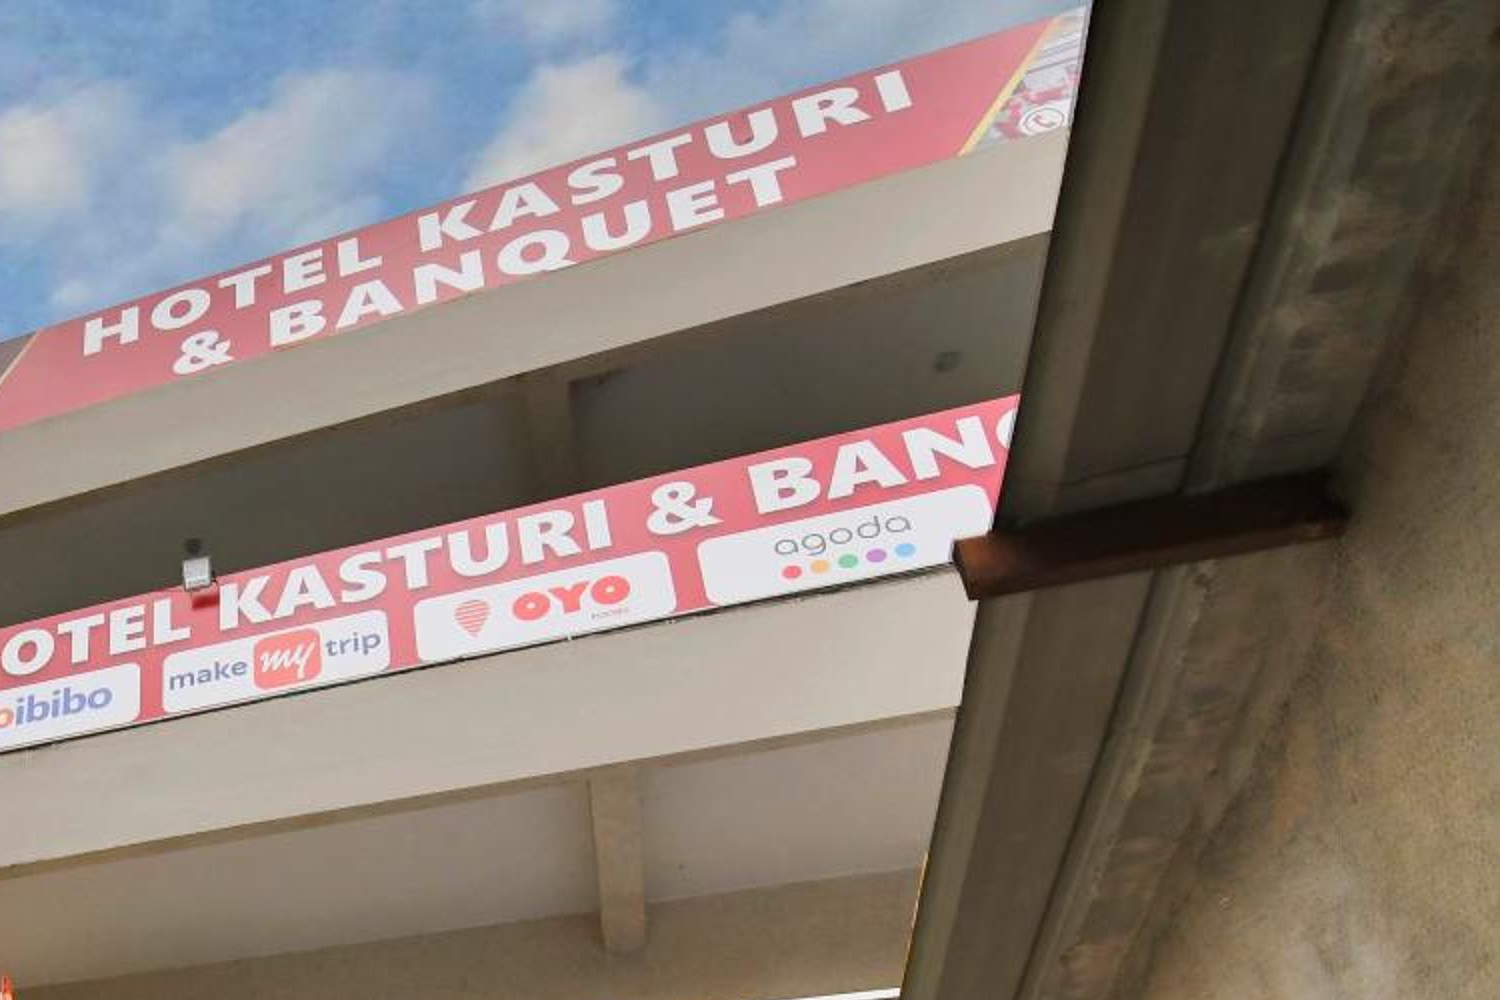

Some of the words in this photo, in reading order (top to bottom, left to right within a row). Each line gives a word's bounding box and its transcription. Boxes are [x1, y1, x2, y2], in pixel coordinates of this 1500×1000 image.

[84, 239, 382, 356] HOTEL
[418, 70, 912, 251] KASTURI
[173, 330, 234, 375] &
[270, 156, 797, 348] BANQUET
[219, 499, 613, 630] KASTURI
[646, 481, 723, 536] &
[512, 575, 631, 621] OYO
[775, 513, 912, 556] agoda
